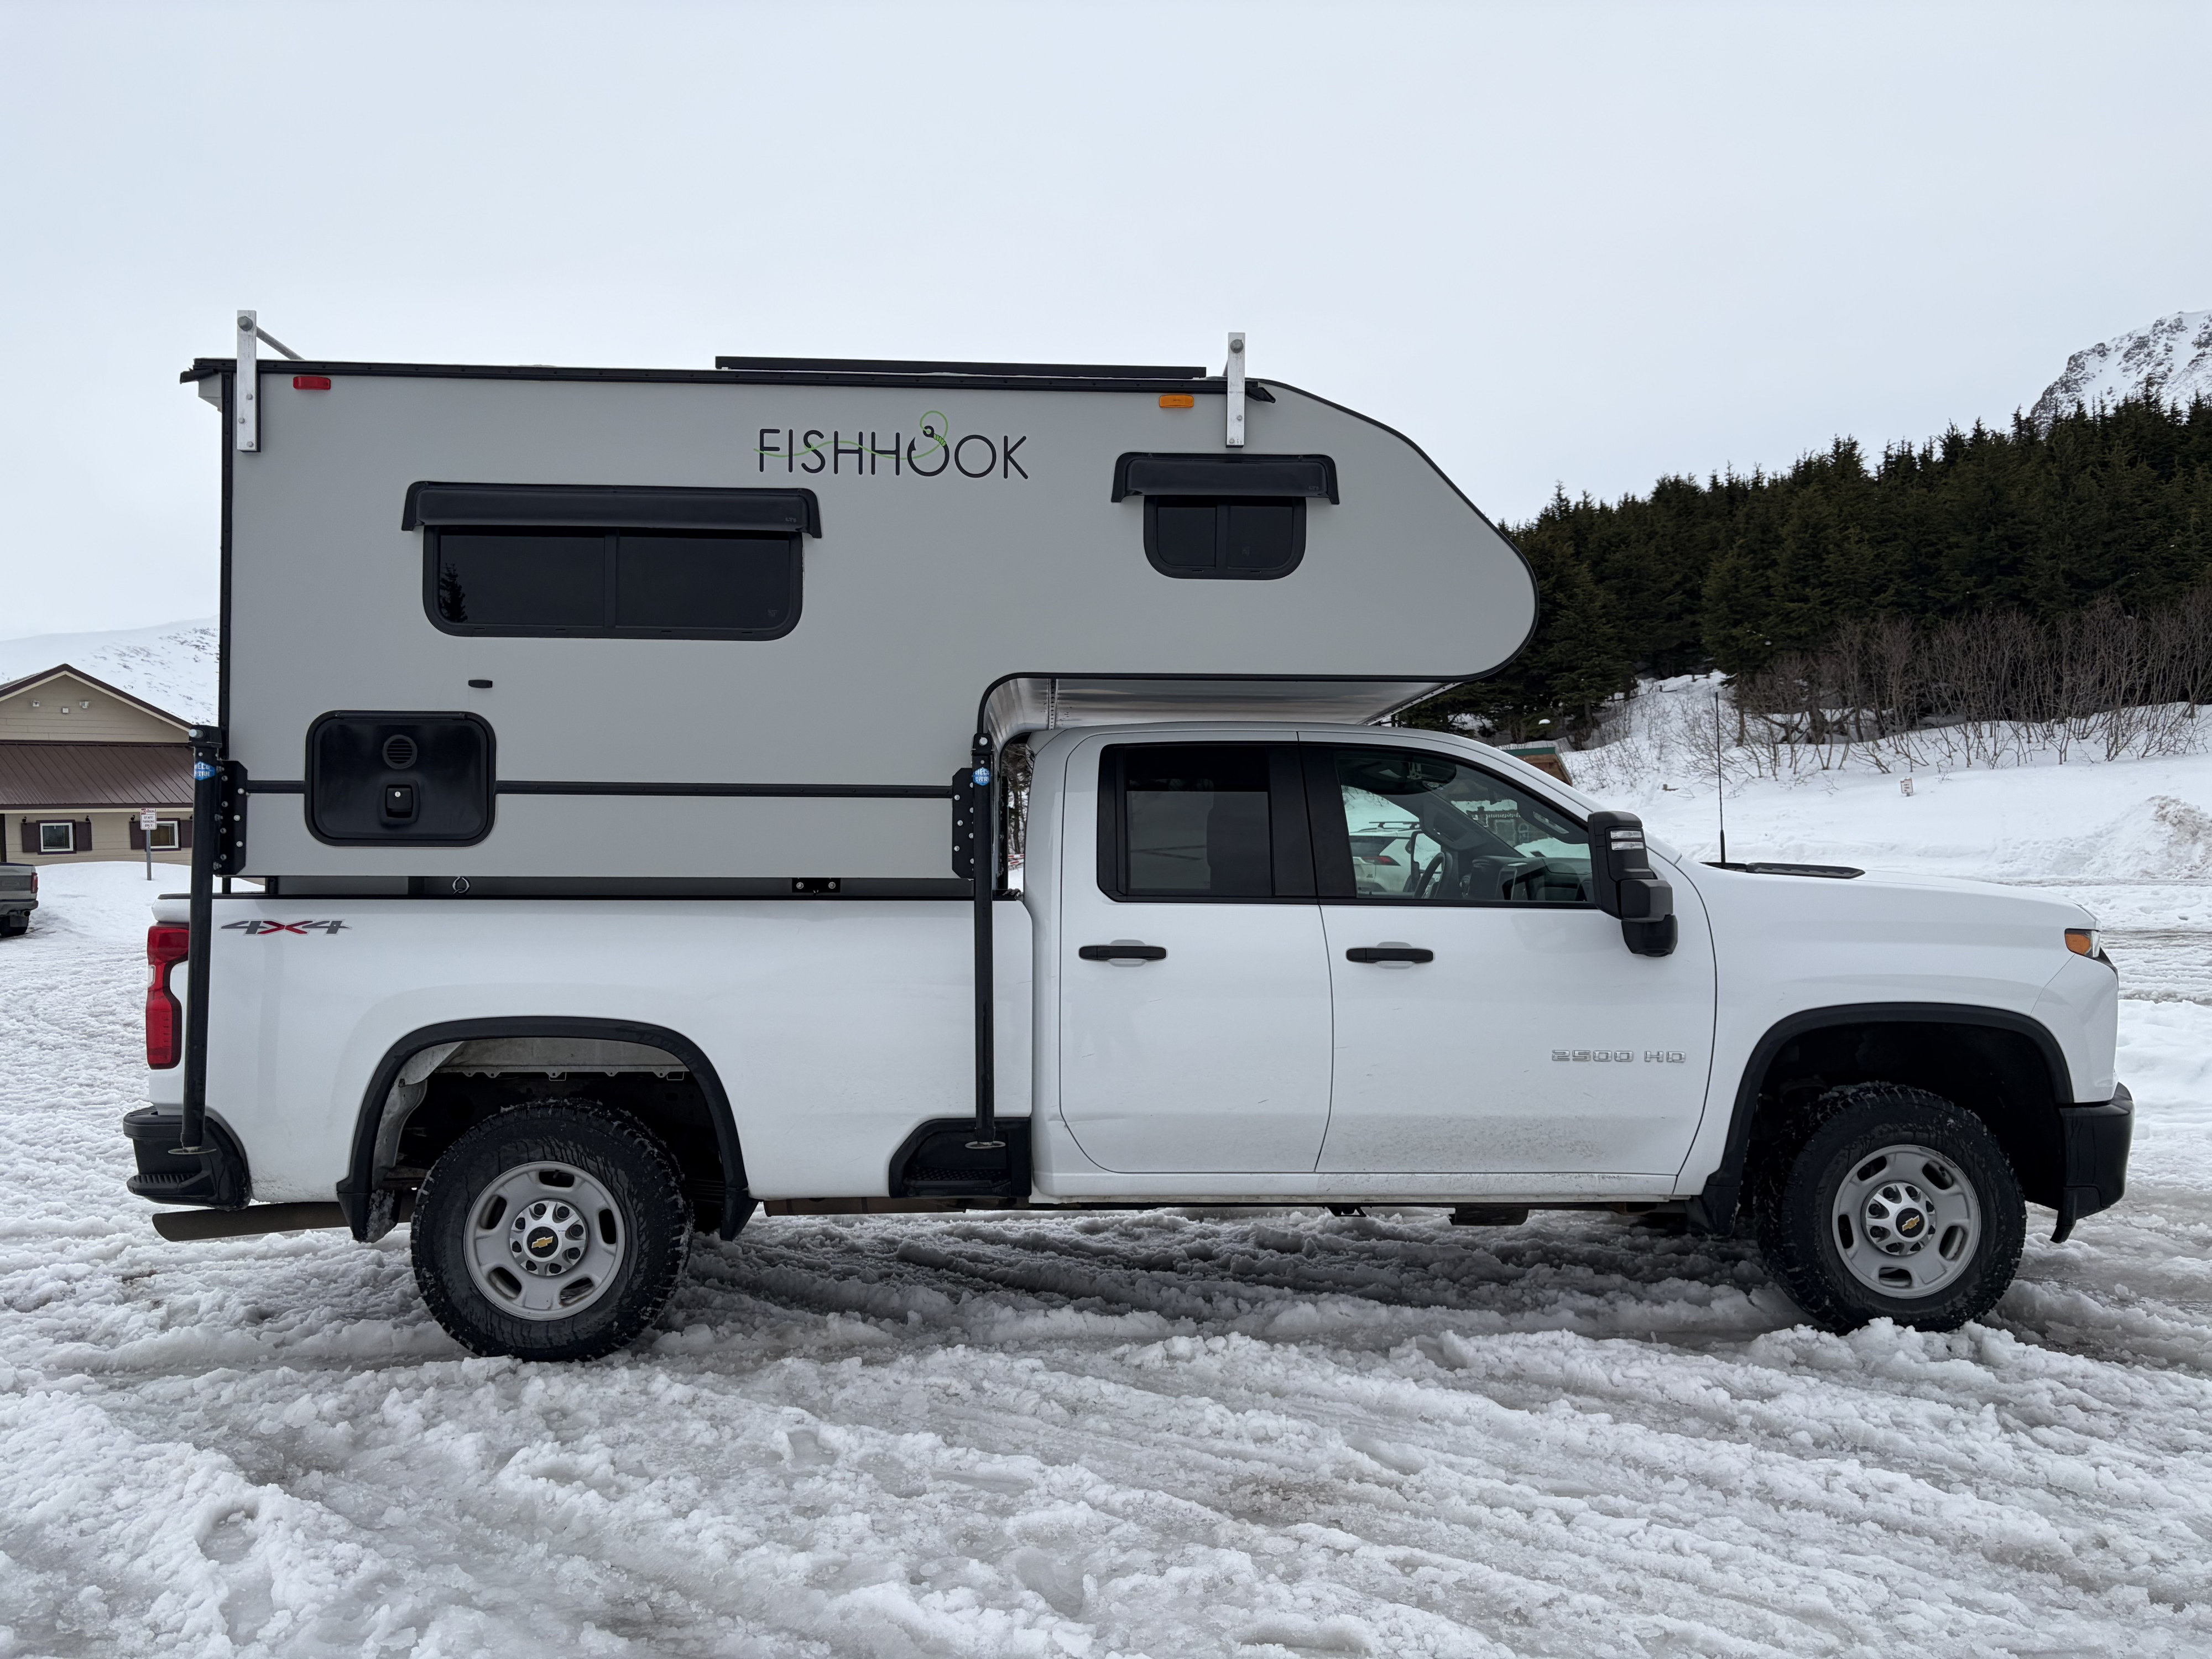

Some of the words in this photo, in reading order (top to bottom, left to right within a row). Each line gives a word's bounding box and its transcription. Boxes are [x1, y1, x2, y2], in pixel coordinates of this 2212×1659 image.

[759, 425, 1029, 479] FISHHOOK
[1552, 1050, 1634, 1062] 2500
[1644, 1051, 1686, 1063] HD
